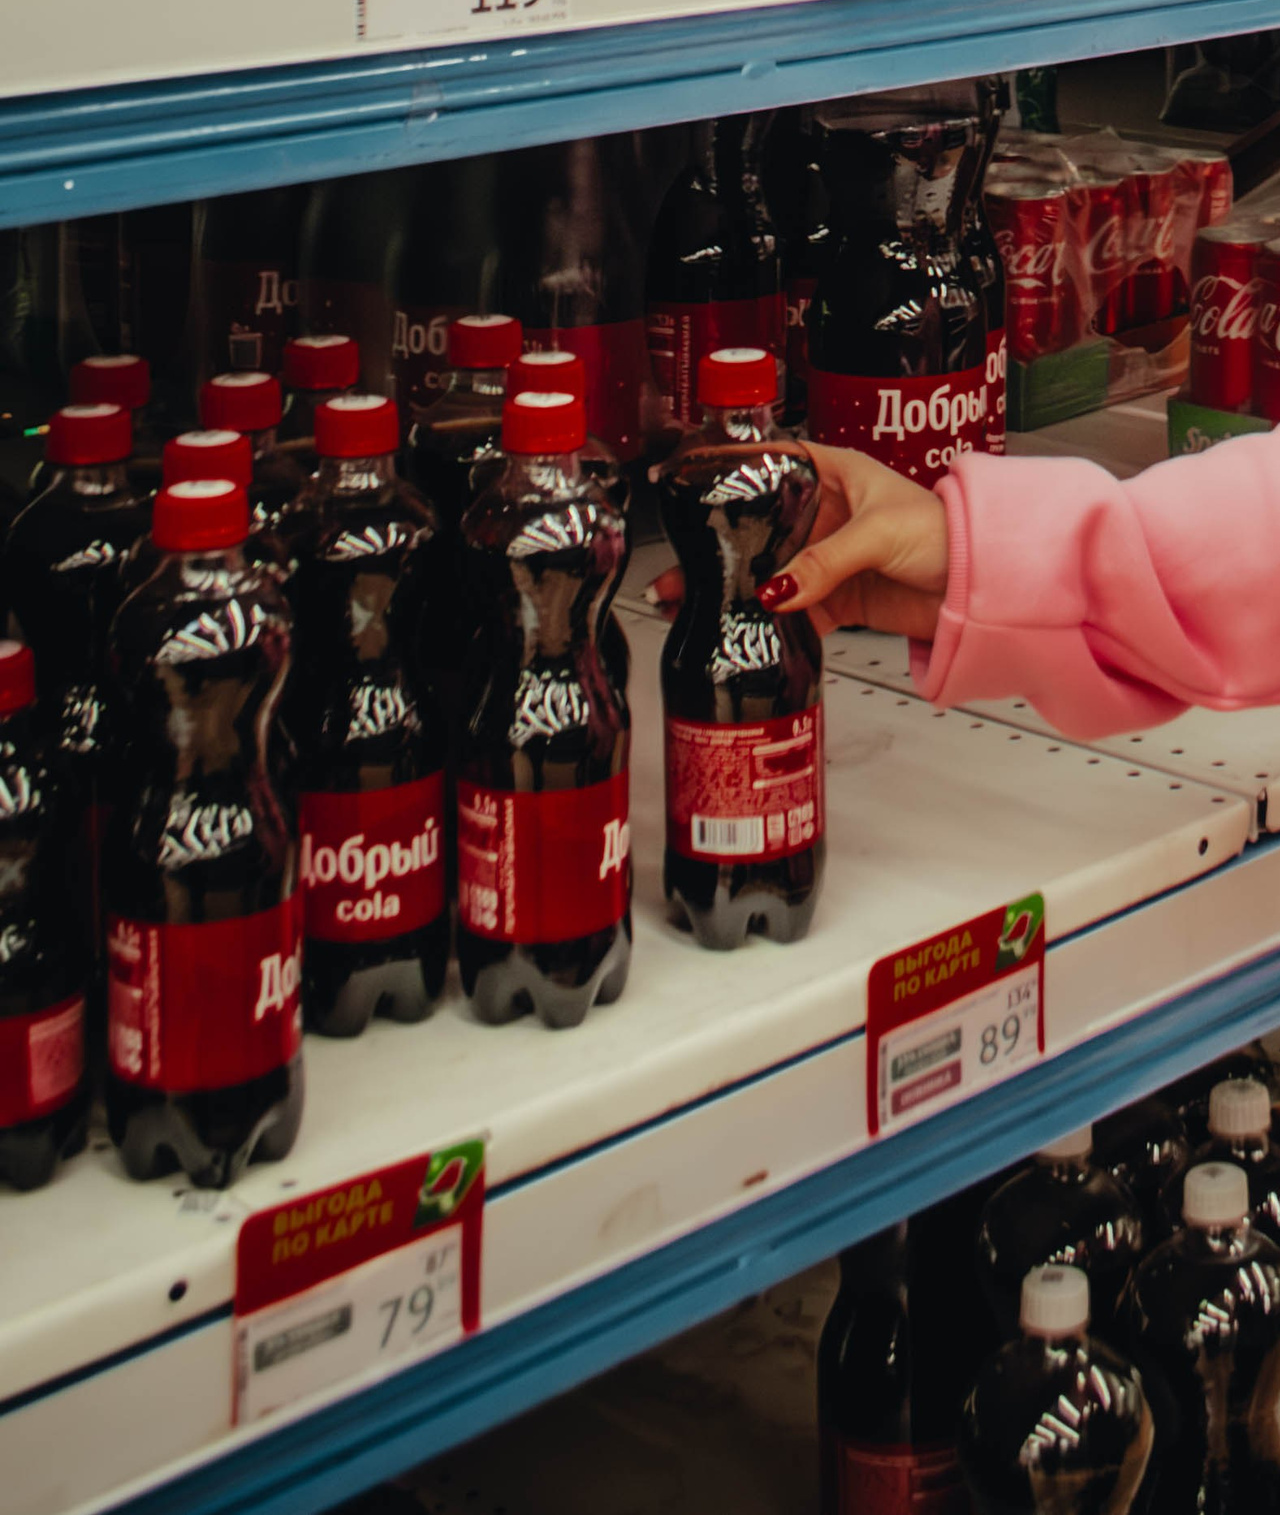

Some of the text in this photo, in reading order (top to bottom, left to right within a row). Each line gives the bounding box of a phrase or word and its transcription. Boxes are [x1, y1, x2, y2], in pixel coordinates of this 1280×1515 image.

[391, 311, 448, 358] Доб
[872, 384, 987, 441] Добры
[336, 891, 400, 923] cola
[894, 929, 973, 980] ВЫГОДА
[894, 947, 981, 1003] ПО КАРТЕ
[980, 1013, 1020, 1065] 89
[272, 1201, 394, 1265] ПО КАРТЕ
[273, 1178, 383, 1237] ВЫГОДА
[379, 1285, 434, 1349] 79
